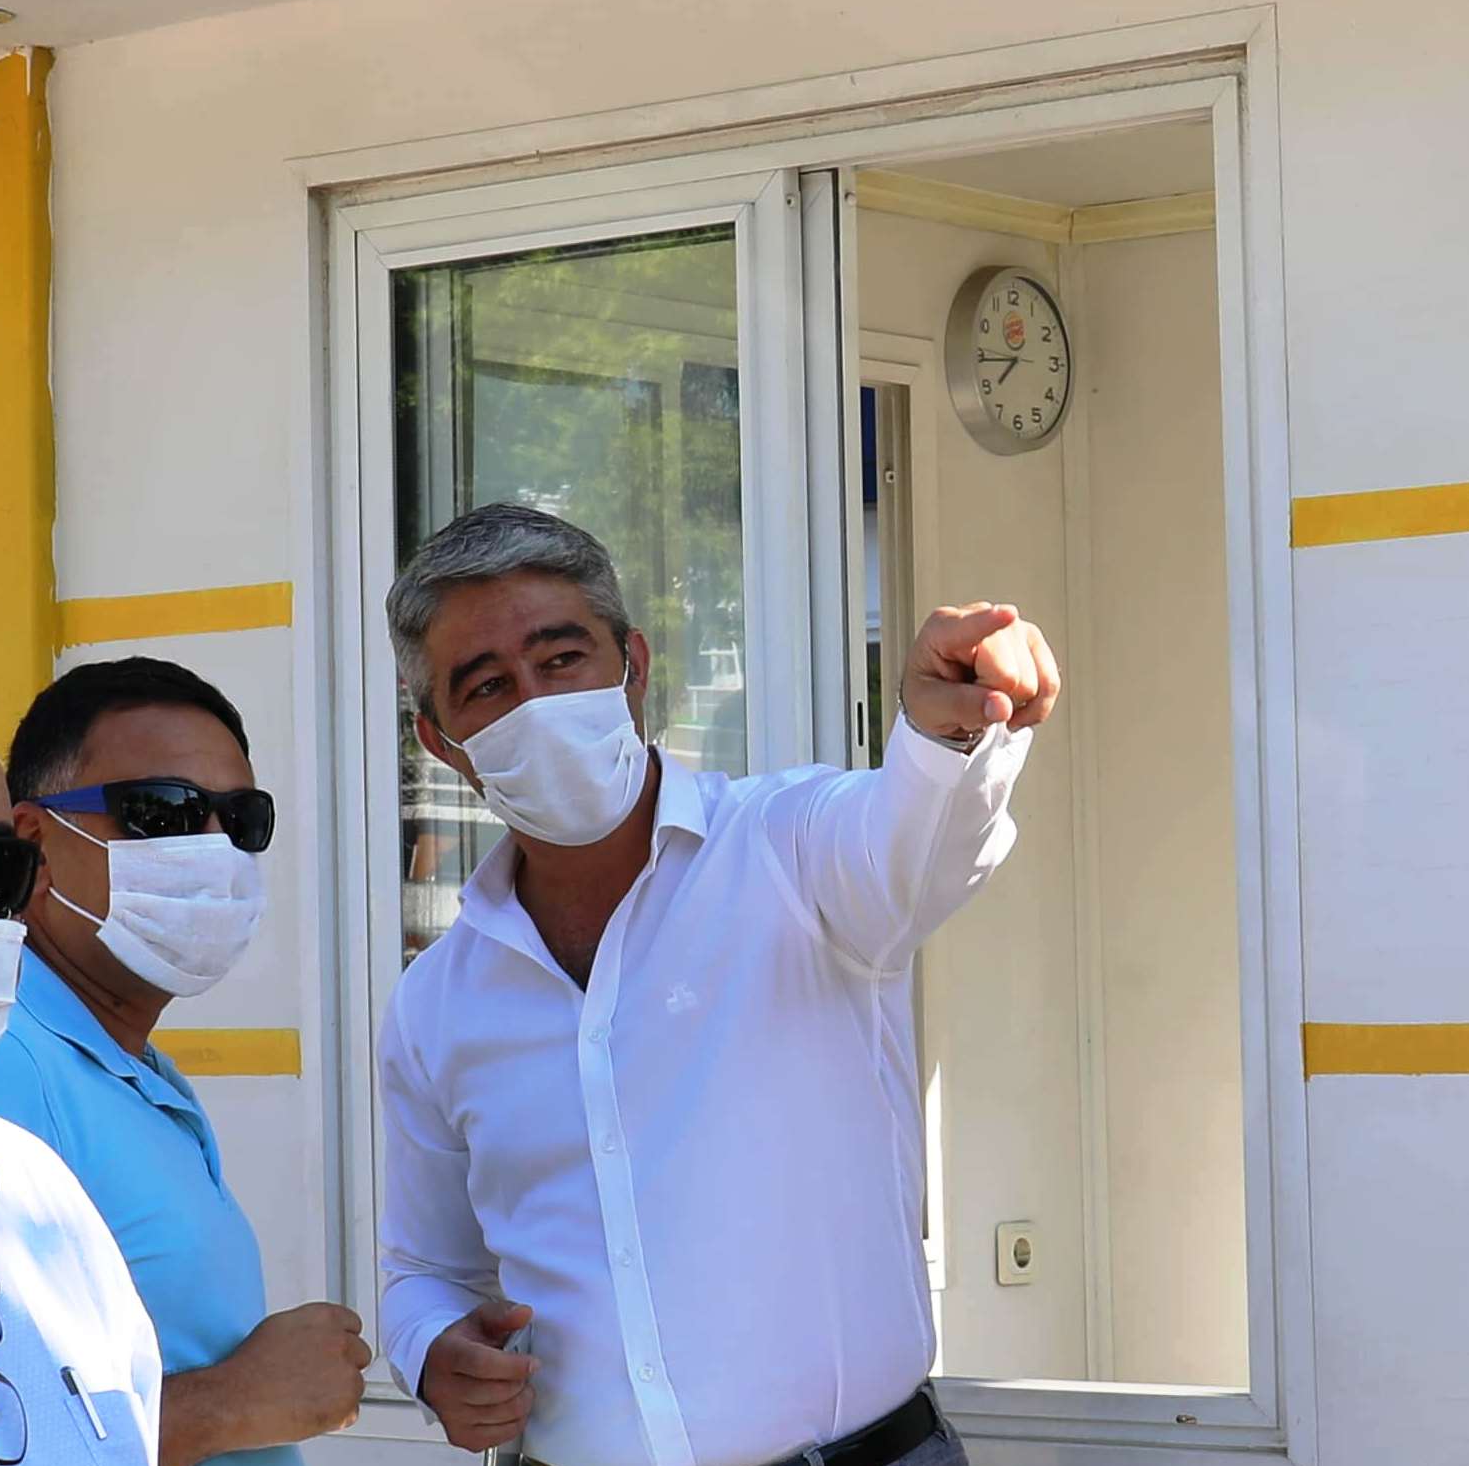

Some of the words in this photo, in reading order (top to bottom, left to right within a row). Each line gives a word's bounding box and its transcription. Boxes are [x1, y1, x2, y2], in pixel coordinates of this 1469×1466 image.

[1007, 290, 1020, 306] 12
[1041, 326, 1052, 342] 2
[1048, 356, 1060, 373] 3
[1012, 414, 1023, 431] 6
